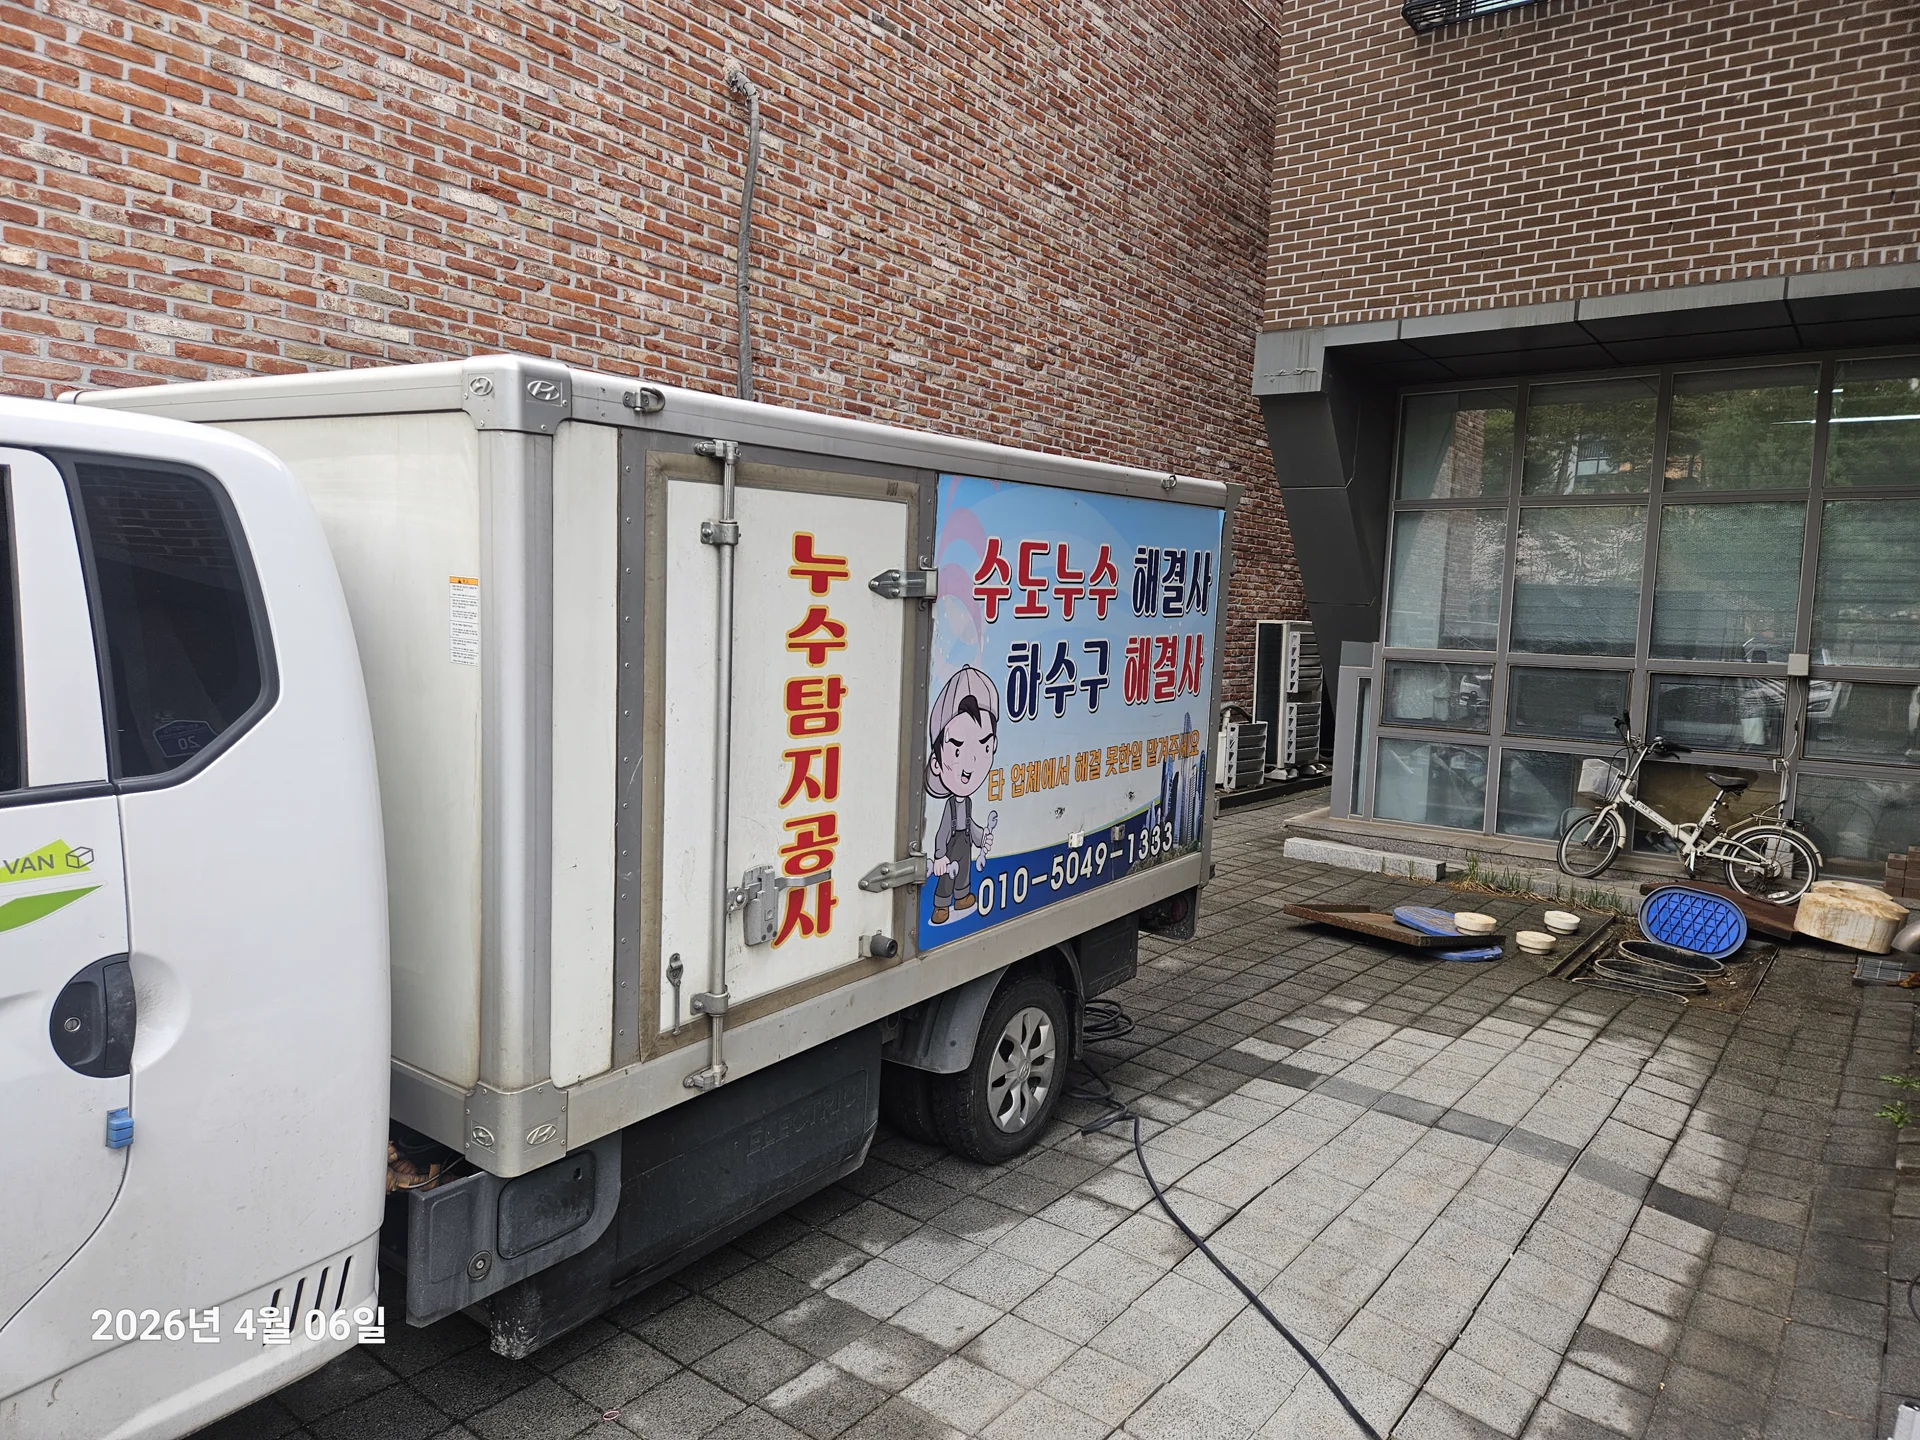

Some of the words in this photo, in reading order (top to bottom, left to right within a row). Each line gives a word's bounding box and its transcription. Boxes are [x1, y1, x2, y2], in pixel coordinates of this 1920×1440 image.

[972, 536, 1118, 623] 수도누수
[1132, 545, 1212, 617] 해결사
[1006, 639, 1110, 722] 하수구
[1124, 632, 1204, 705] 해결사
[771, 531, 850, 949] 누수탐지공사
[987, 768, 1005, 801] 타
[1010, 757, 1070, 798] 업체에서
[1074, 749, 1101, 782] 해결
[1105, 740, 1143, 777] 못한일
[1146, 729, 1200, 767] 맡겨주세요
[3, 853, 55, 875] VAN
[977, 821, 1173, 916] 010-5049-1333
[747, 1085, 857, 1157] ELECTRIC
